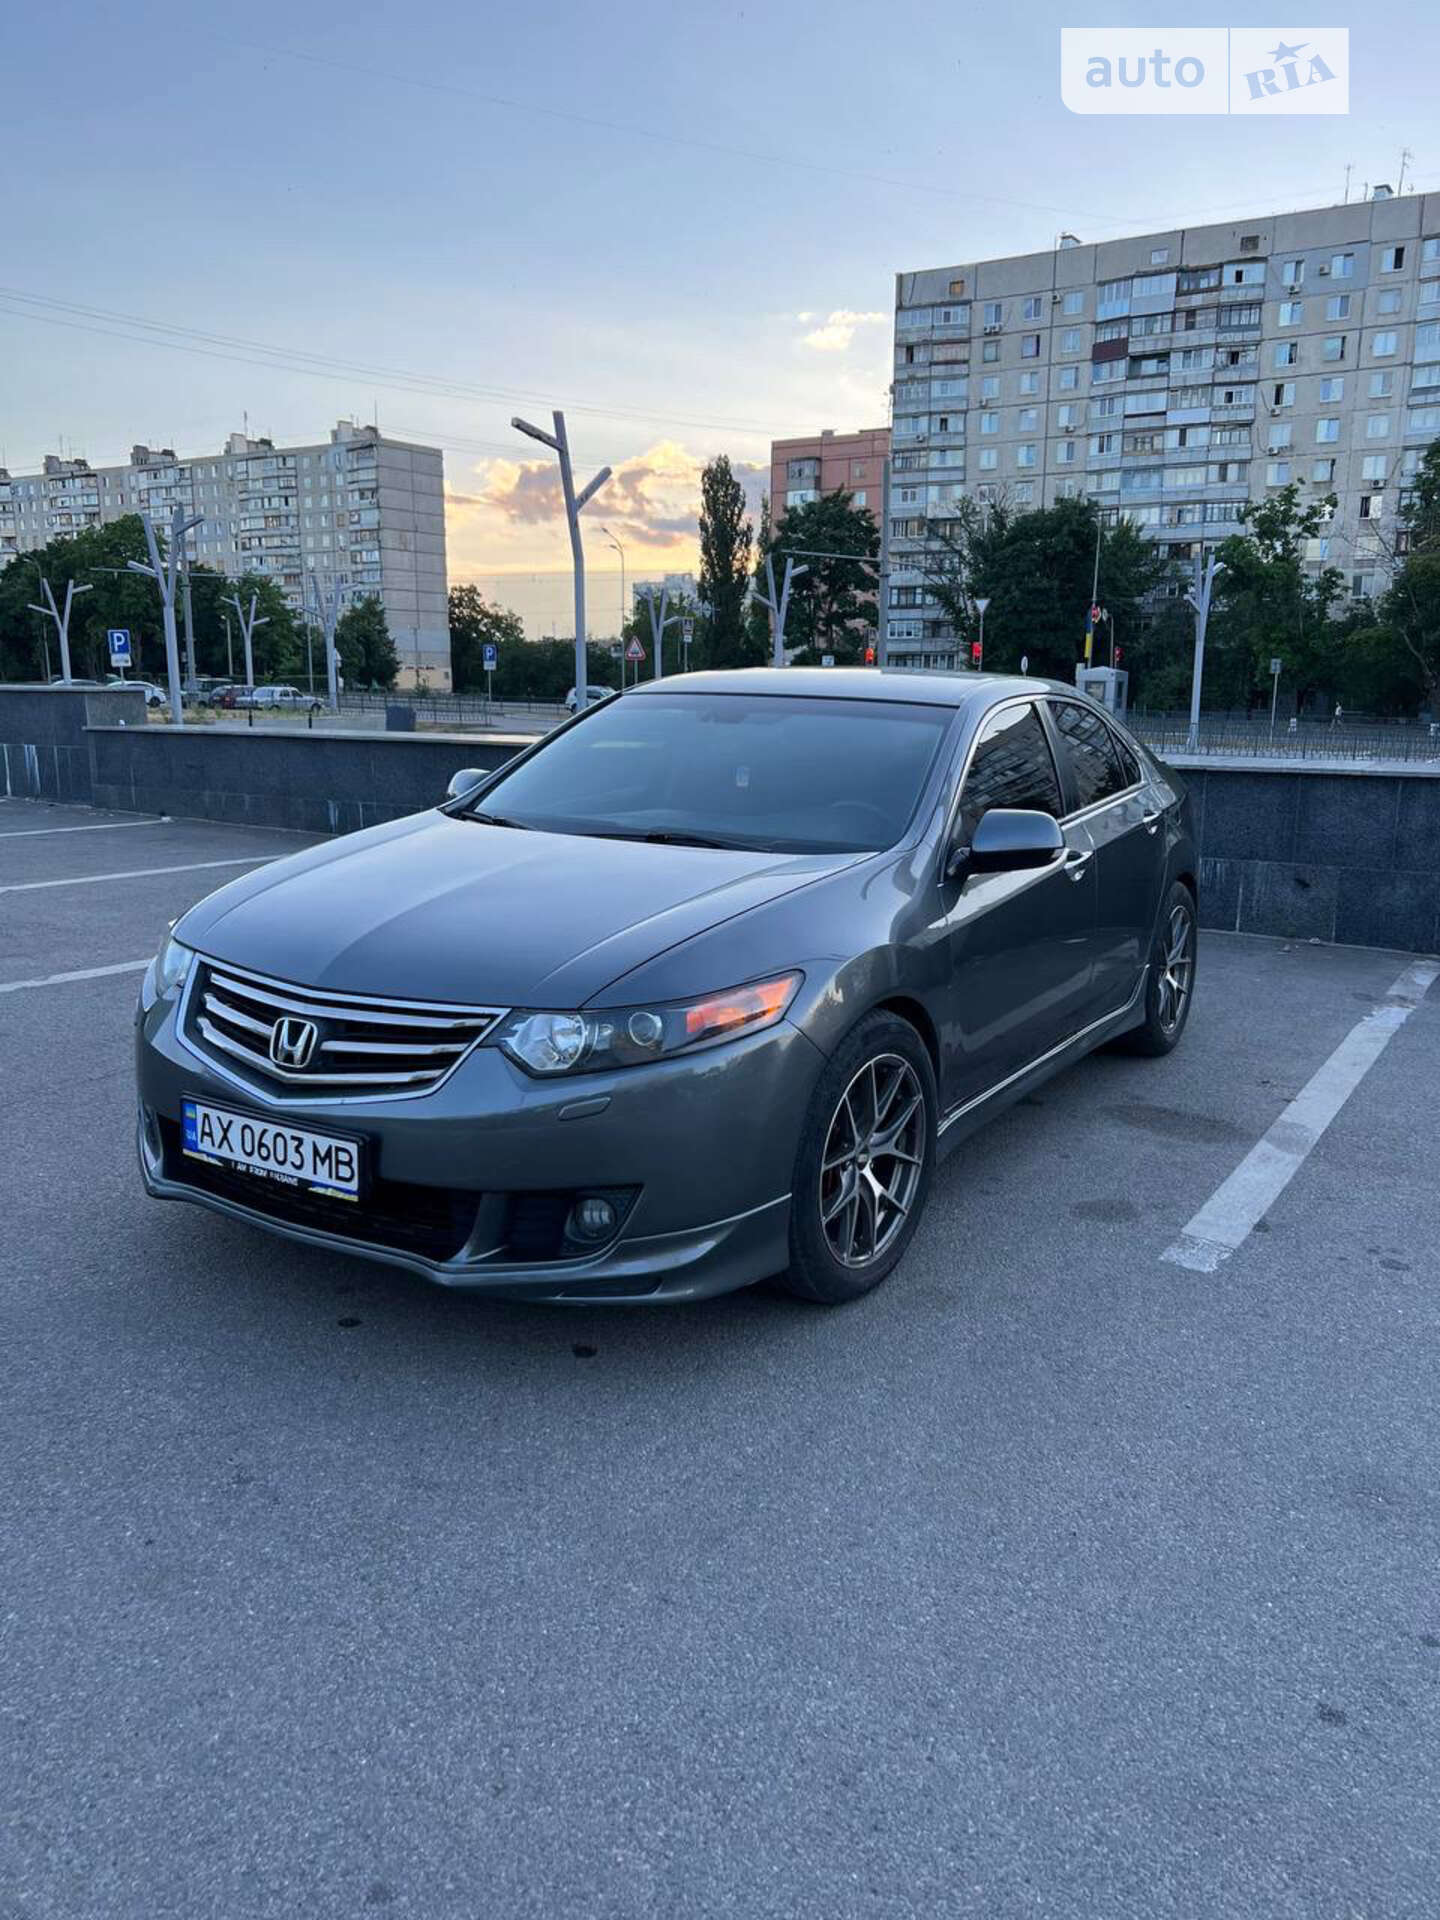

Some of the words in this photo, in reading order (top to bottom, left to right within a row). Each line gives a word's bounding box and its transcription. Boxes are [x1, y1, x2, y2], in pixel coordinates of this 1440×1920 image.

[113, 632, 125, 652] P
[200, 1112, 235, 1153] AX
[241, 1124, 305, 1170] 0603
[312, 1140, 355, 1183] MB
